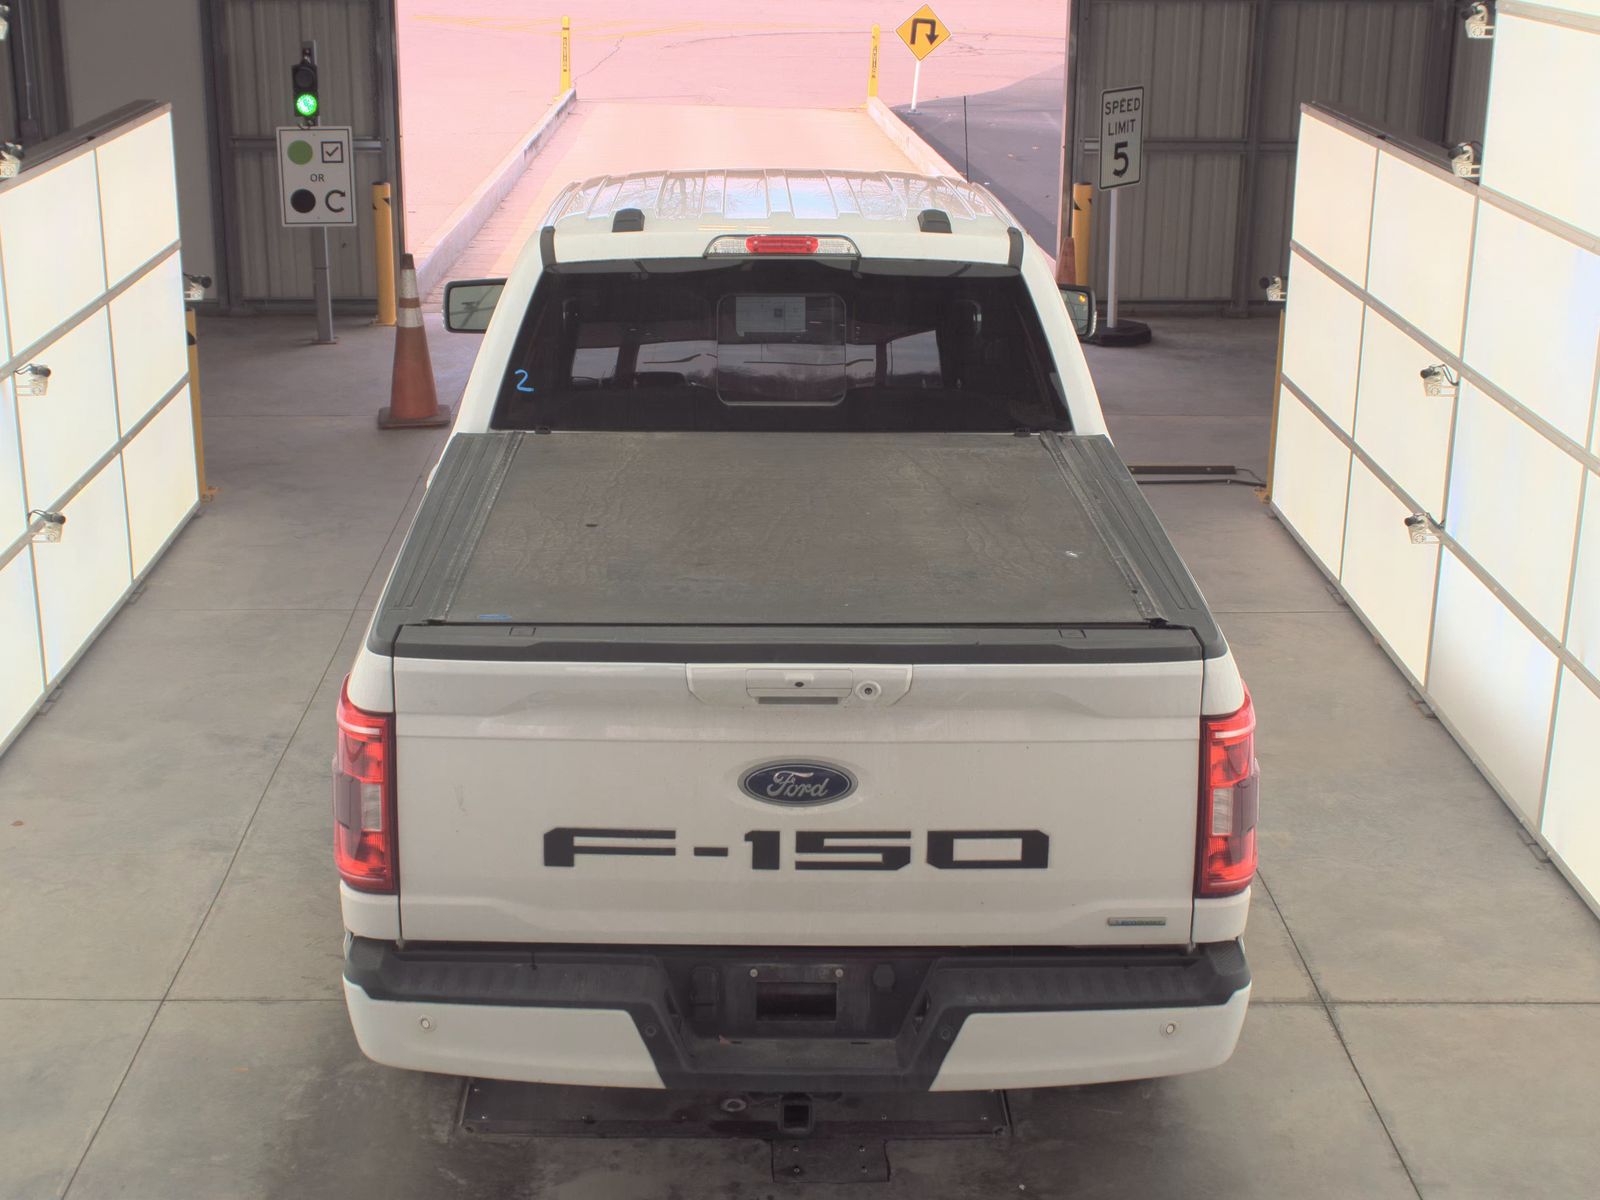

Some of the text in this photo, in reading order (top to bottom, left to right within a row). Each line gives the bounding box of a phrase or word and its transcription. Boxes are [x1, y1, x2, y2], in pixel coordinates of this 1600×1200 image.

[1105, 97, 1140, 115] SPEED
[1108, 119, 1136, 136] LIMIT
[1113, 141, 1129, 178] 5
[310, 173, 324, 182] OR
[514, 369, 535, 392] 2
[766, 770, 829, 798] Ford
[543, 827, 1050, 871] F-150
